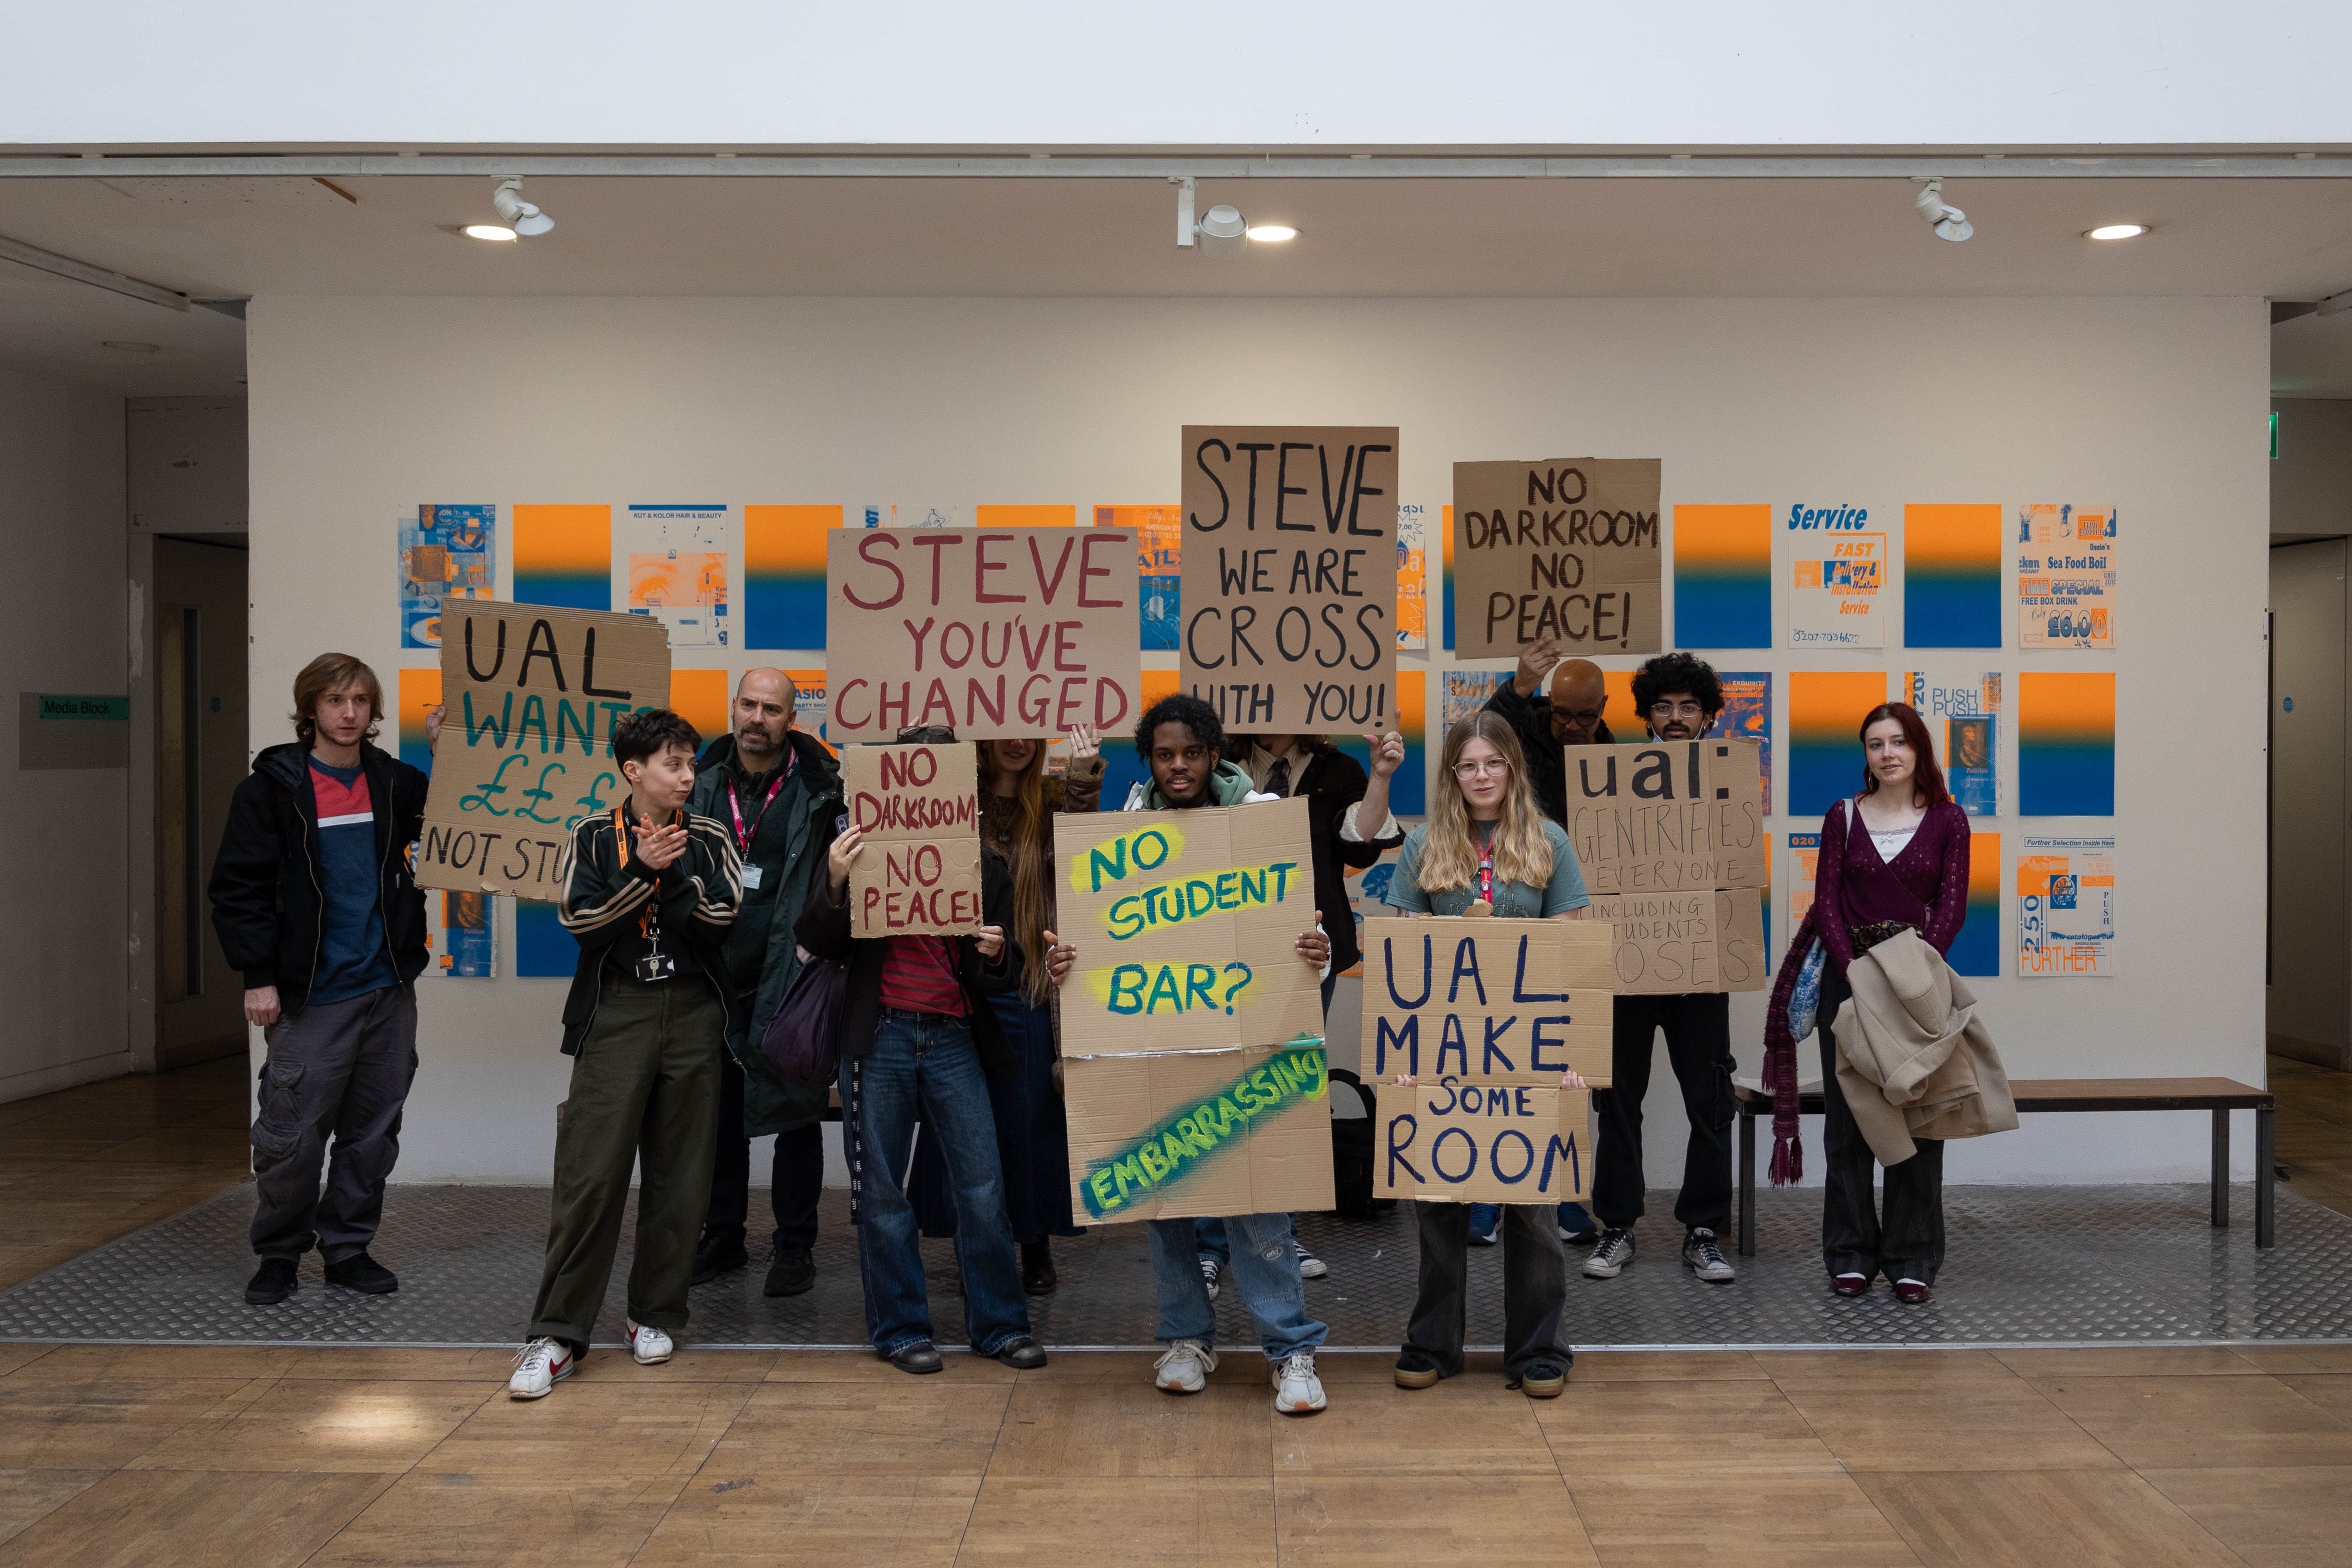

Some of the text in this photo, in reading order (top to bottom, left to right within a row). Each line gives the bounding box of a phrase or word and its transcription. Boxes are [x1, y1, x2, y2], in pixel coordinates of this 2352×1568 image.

[1190, 438, 1392, 537] STEVE
[1528, 467, 1587, 505] NO
[1464, 509, 1658, 549] DARKROOM
[1788, 504, 1867, 530] Service
[1139, 549, 1181, 568] AIL
[1531, 552, 1584, 590] NO
[1833, 543, 1875, 557] FAST
[1833, 561, 1876, 581] Delivery &
[2048, 557, 2107, 569] Sea Food Boil
[843, 533, 1129, 611] STEVE
[1218, 548, 1366, 597] WE ARE
[1831, 581, 1878, 596] Installation
[2051, 580, 2103, 595] SPECIAL
[1486, 592, 1631, 649] PEACE!
[1839, 599, 1869, 615] Service
[2048, 610, 2107, 638] £6.00
[465, 617, 632, 700] UAL
[904, 614, 1087, 672] YOU'VE
[1187, 604, 1384, 670] CROSS
[45, 700, 110, 714] Media Block
[835, 673, 1128, 732] CHANGED
[1303, 681, 1385, 727] YOU!
[1932, 688, 1977, 704] PUSH
[1933, 702, 1978, 717] PUSH
[880, 748, 937, 791] NO
[1578, 742, 1730, 800] ual:
[855, 791, 976, 834] DARKROOM
[1575, 802, 1755, 864] GENTRIFIES
[425, 826, 501, 876] NOT
[1089, 830, 1169, 894] NO
[1792, 837, 1815, 845] 020
[886, 844, 942, 887] NO
[1597, 860, 1745, 888] EVERYONE
[864, 886, 981, 930] PEACE!
[1107, 862, 1297, 941] STUDENT
[2024, 895, 2039, 954] 250
[1384, 933, 1571, 1010] UAL
[2021, 946, 2097, 971] FURTHER
[1106, 962, 1253, 1016] BAR?
[1375, 1013, 1574, 1076] MAKE
[1428, 1075, 1536, 1117] SOME
[1387, 1114, 1581, 1194] ROOM
